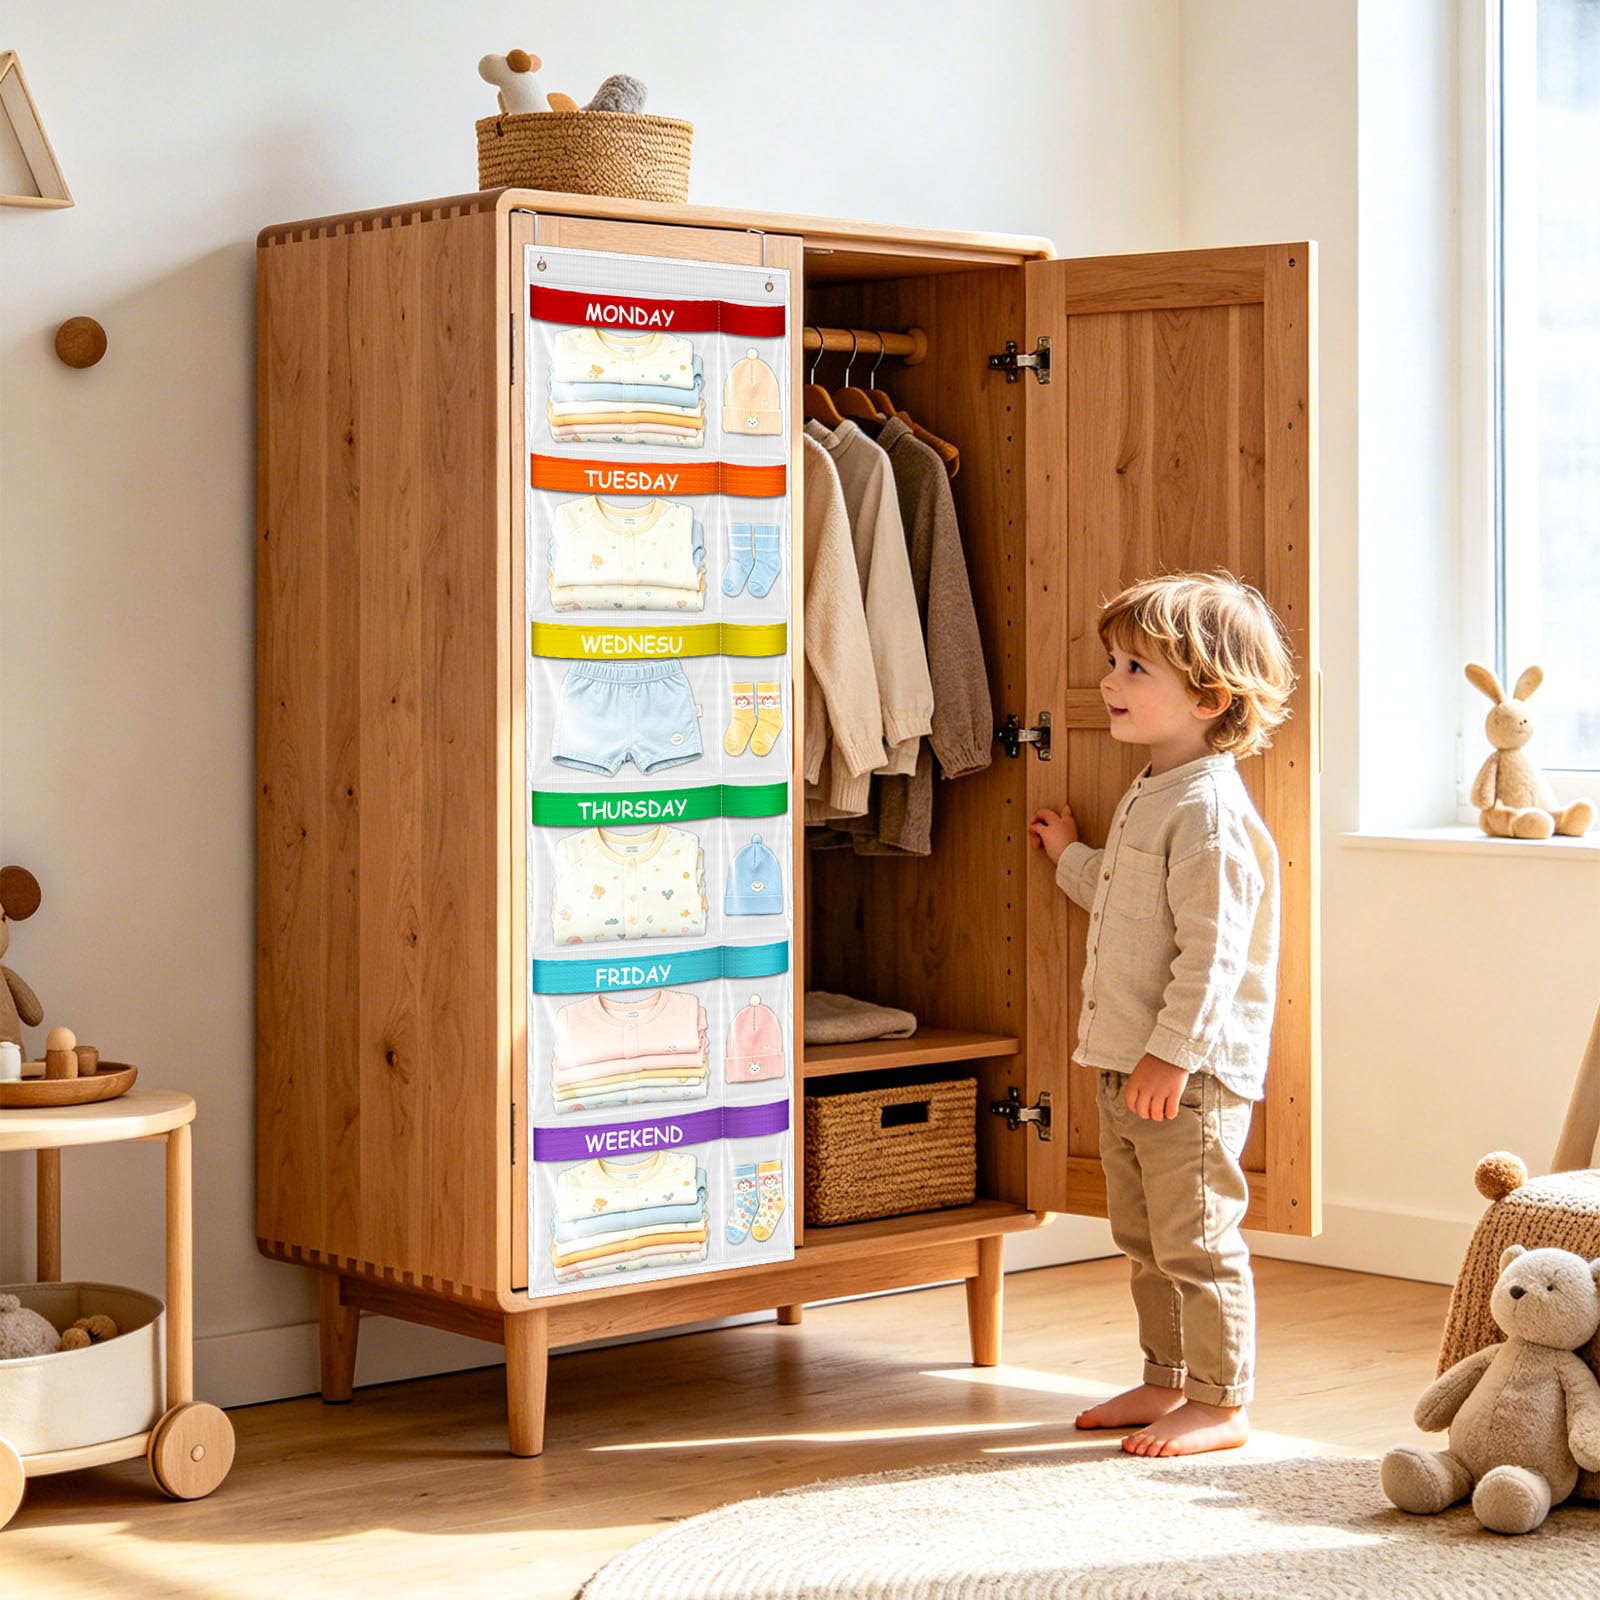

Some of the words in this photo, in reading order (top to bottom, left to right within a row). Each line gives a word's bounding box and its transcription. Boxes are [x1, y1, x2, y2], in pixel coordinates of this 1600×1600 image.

[585, 303, 675, 328] MONDAY
[584, 469, 679, 491] TUESDAY
[581, 634, 683, 655] WEDNESU
[577, 799, 688, 821] THURSDAY
[595, 964, 672, 988] FRIDAY
[584, 1125, 684, 1153] WEEKEND
